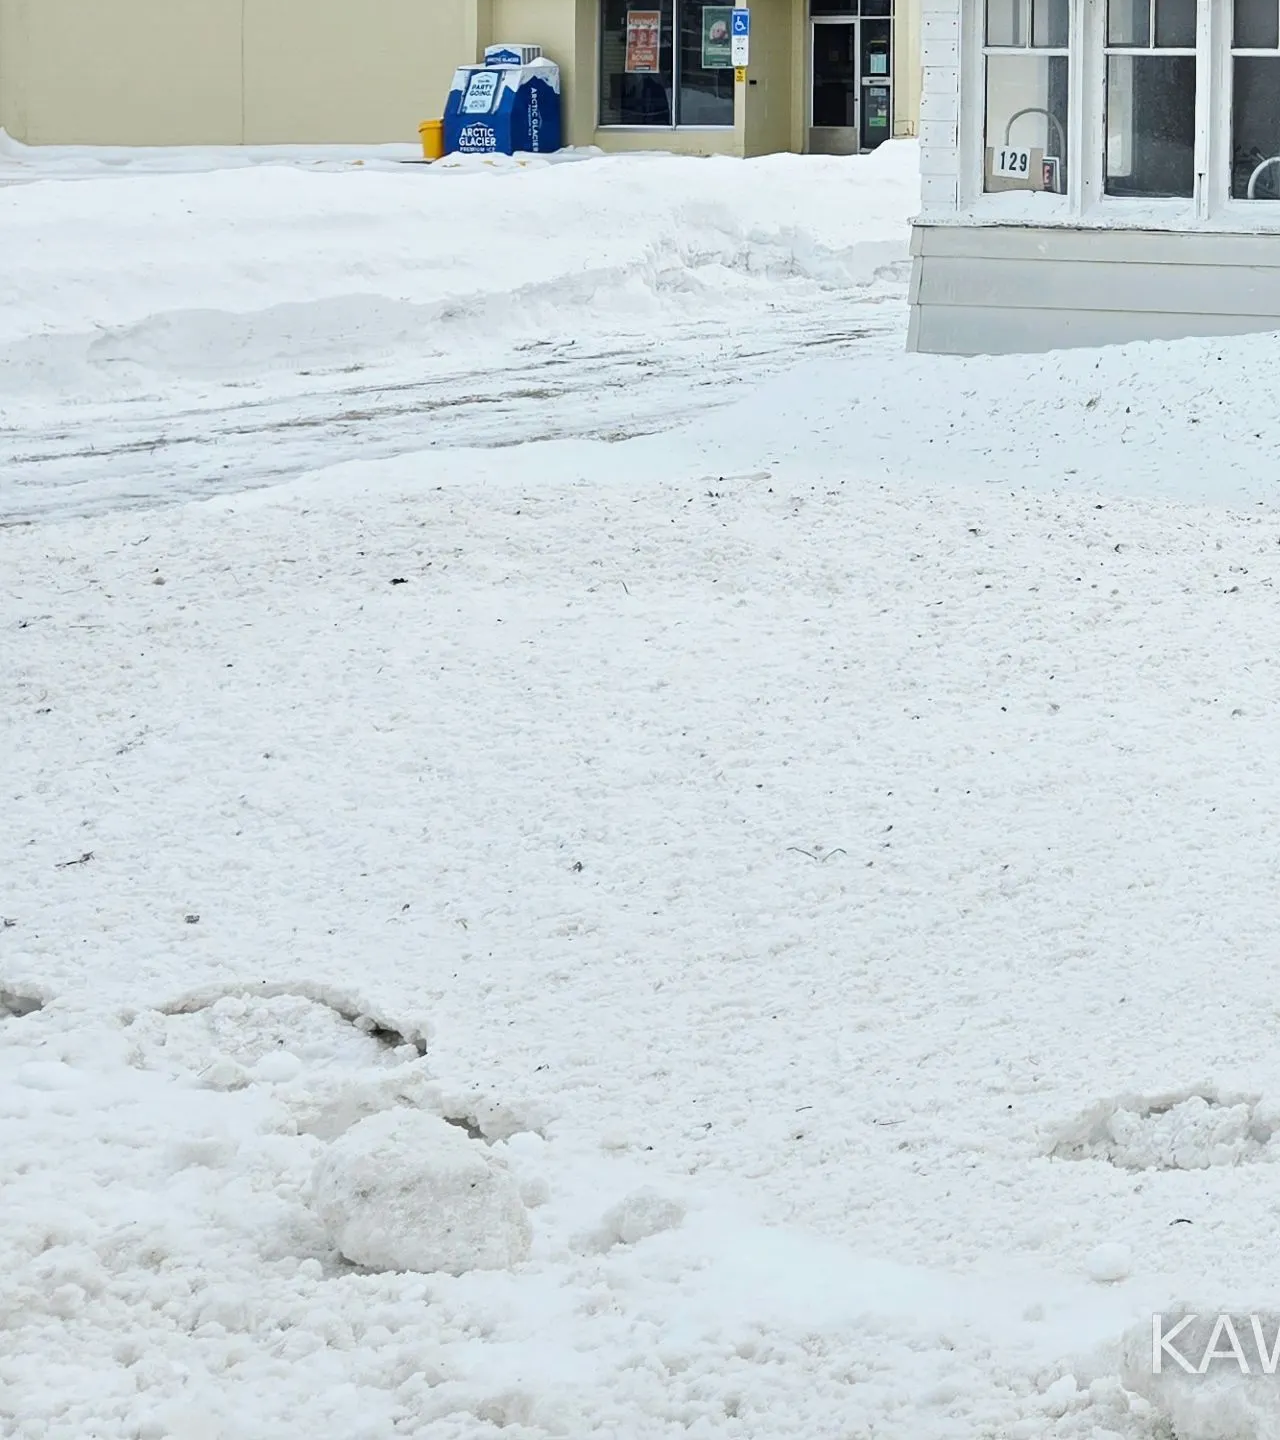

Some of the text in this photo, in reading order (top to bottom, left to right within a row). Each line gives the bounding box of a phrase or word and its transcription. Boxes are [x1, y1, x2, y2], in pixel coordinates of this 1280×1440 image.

[531, 87, 539, 115] ARCTIC
[461, 128, 494, 137] ARCTIC
[459, 137, 497, 146] GLACIER
[1001, 151, 1027, 172] 129
